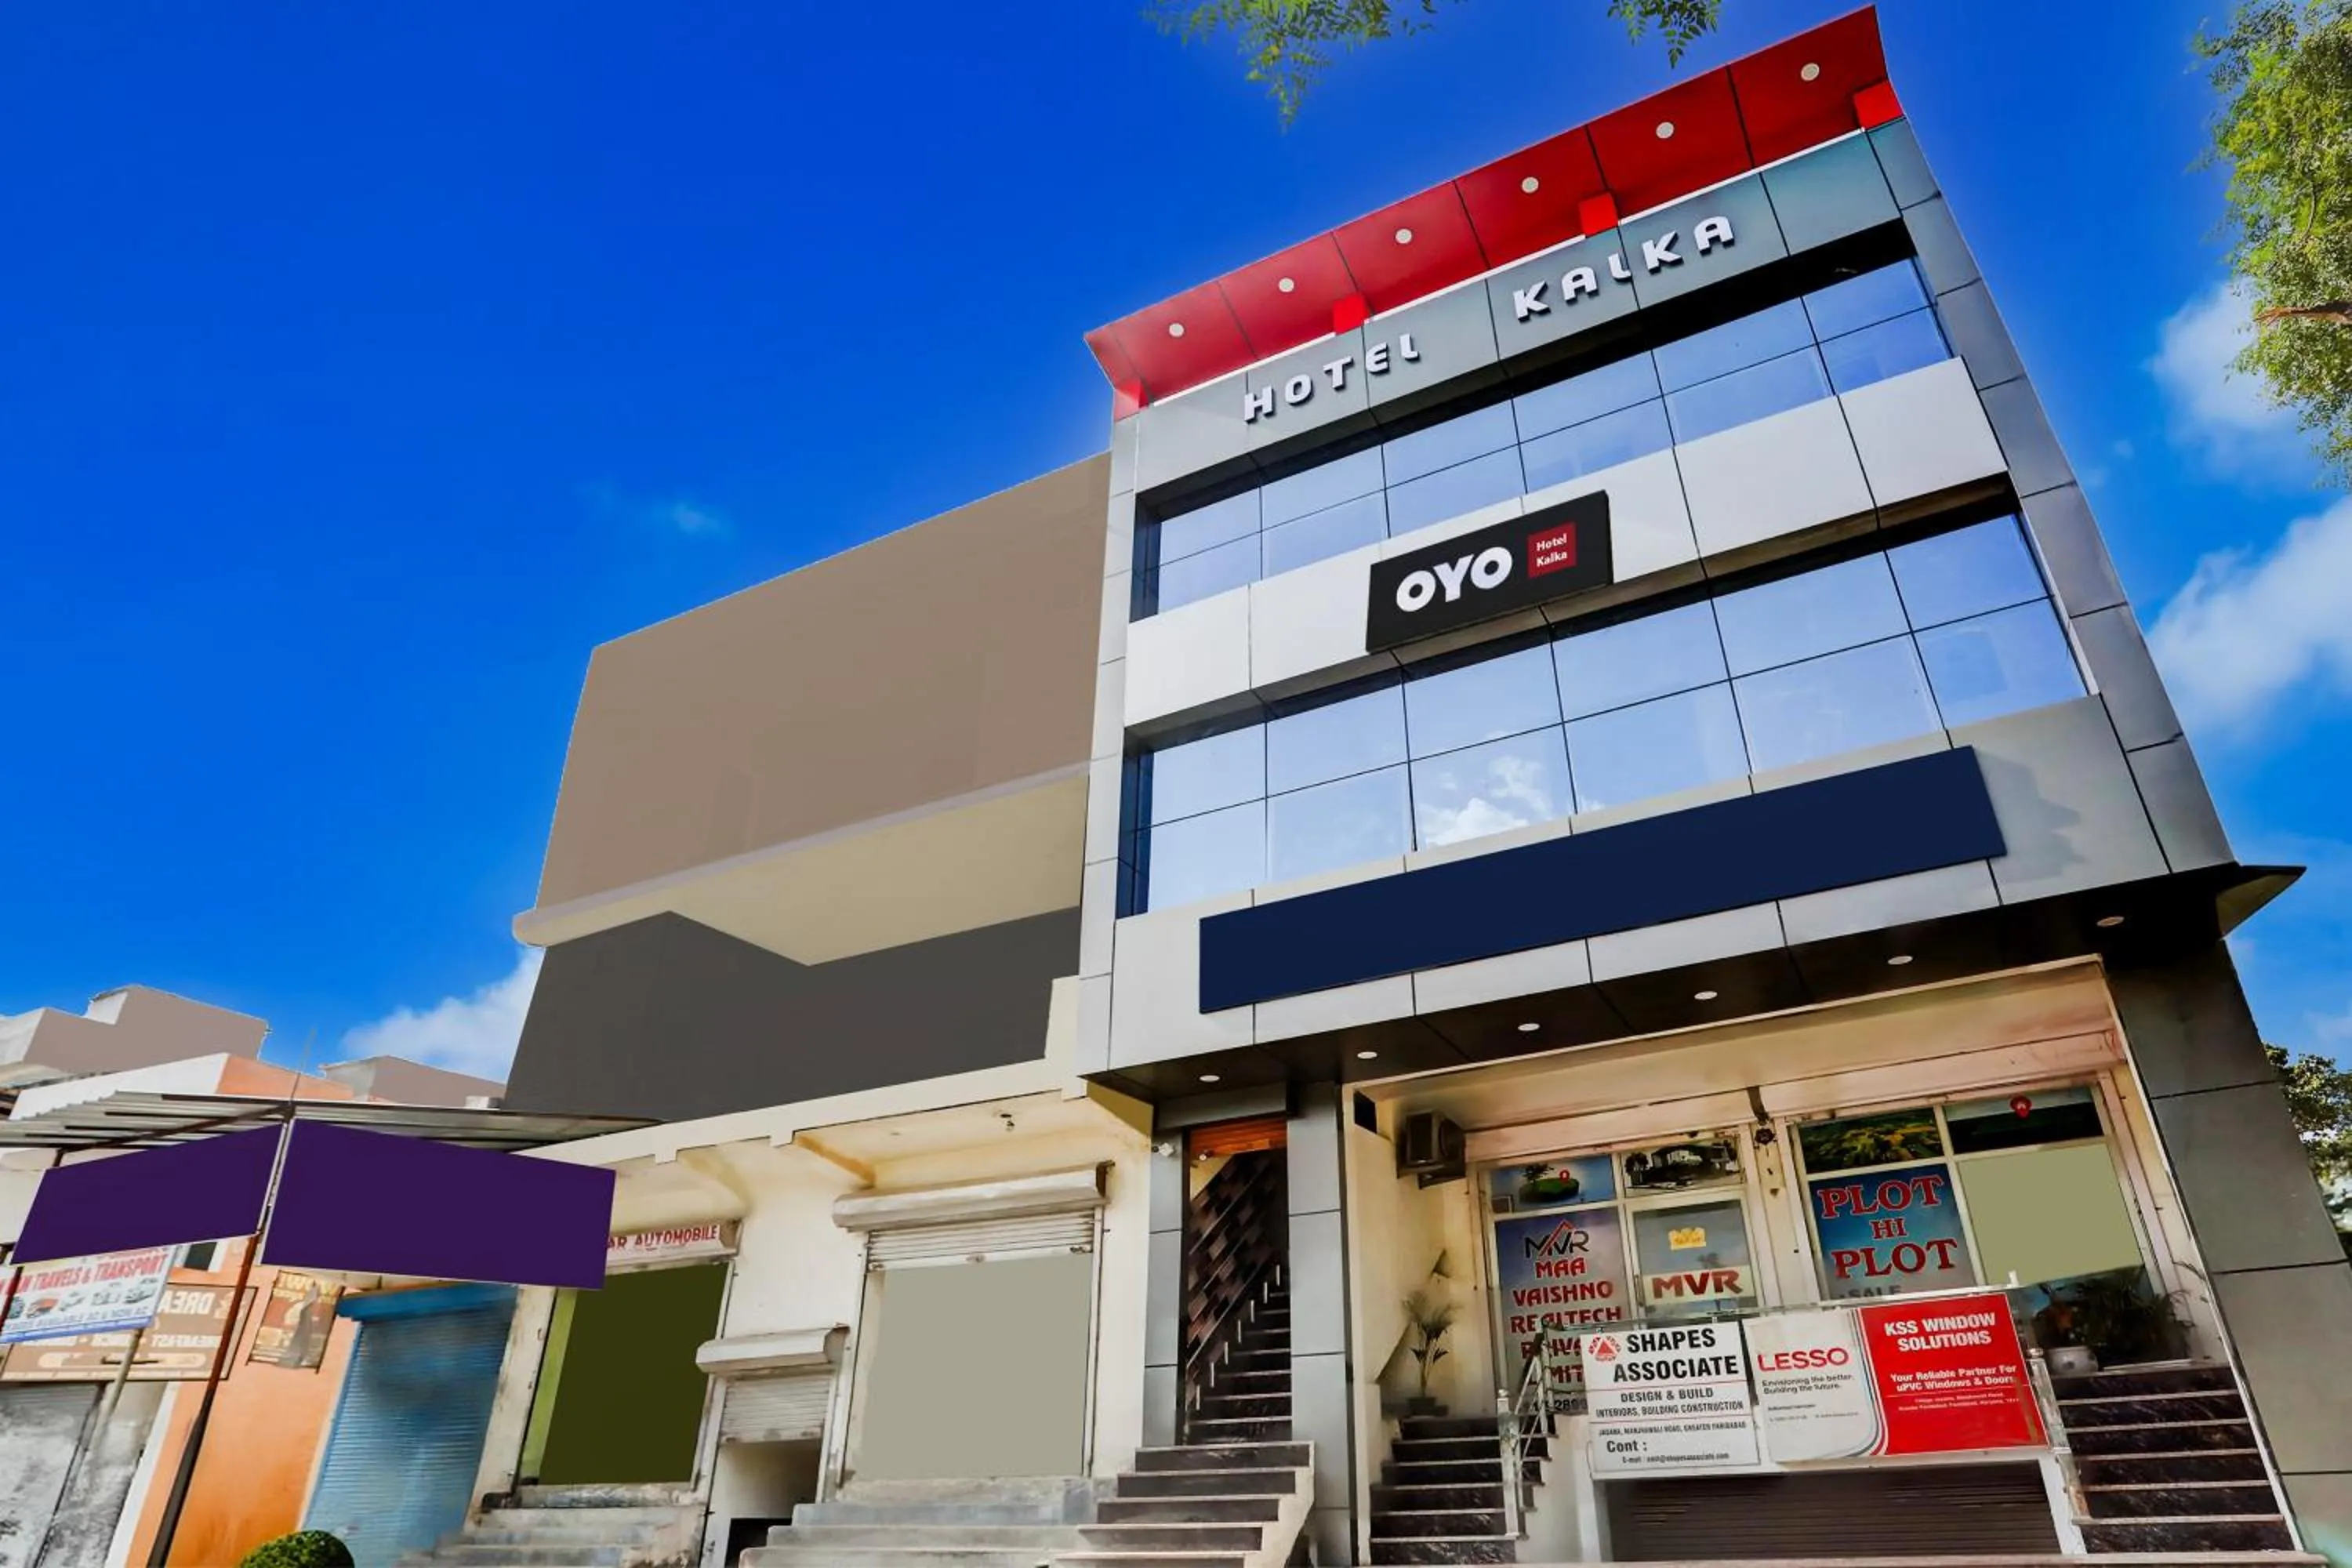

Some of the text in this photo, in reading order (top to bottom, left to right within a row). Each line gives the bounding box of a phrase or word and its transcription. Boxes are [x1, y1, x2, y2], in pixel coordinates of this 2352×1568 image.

[1243, 216, 1734, 423] HOTEL KALKA
[1536, 533, 1567, 551] Hotel
[1536, 552, 1568, 568] Kalka
[1396, 546, 1512, 612] OYO
[1817, 1174, 1944, 1218] PLOT
[635, 1225, 718, 1247] AUTOMOBILE
[1870, 1218, 1908, 1240] HI
[1535, 1258, 1586, 1279] MAA
[1831, 1238, 1958, 1279] PLOT
[34, 1266, 80, 1290] TRAVELS
[93, 1254, 168, 1282] TRANSPORT
[1512, 1280, 1613, 1307] VAISHNO
[1652, 1270, 1743, 1299] MVR
[1884, 1312, 1995, 1337] KSS WINDOW
[1627, 1328, 1715, 1353] SHAPES
[1897, 1330, 1991, 1352] SOLUTIONS
[1613, 1356, 1739, 1382] ASSOCIATE
[1758, 1347, 1849, 1371] LESSO
[1762, 1377, 1809, 1387] Envisioning
[1890, 1364, 2016, 1382] Your Reliable Partner For
[1621, 1387, 1714, 1403] DESIGN & BUILD
[1763, 1386, 1798, 1395] Building
[1896, 1382, 1923, 1392] uPVC
[1925, 1379, 1971, 1389] Windows
[1596, 1401, 1744, 1418] INTERIORS, BUILDING CONSTRUCTION
[1606, 1440, 1639, 1453] Cont
